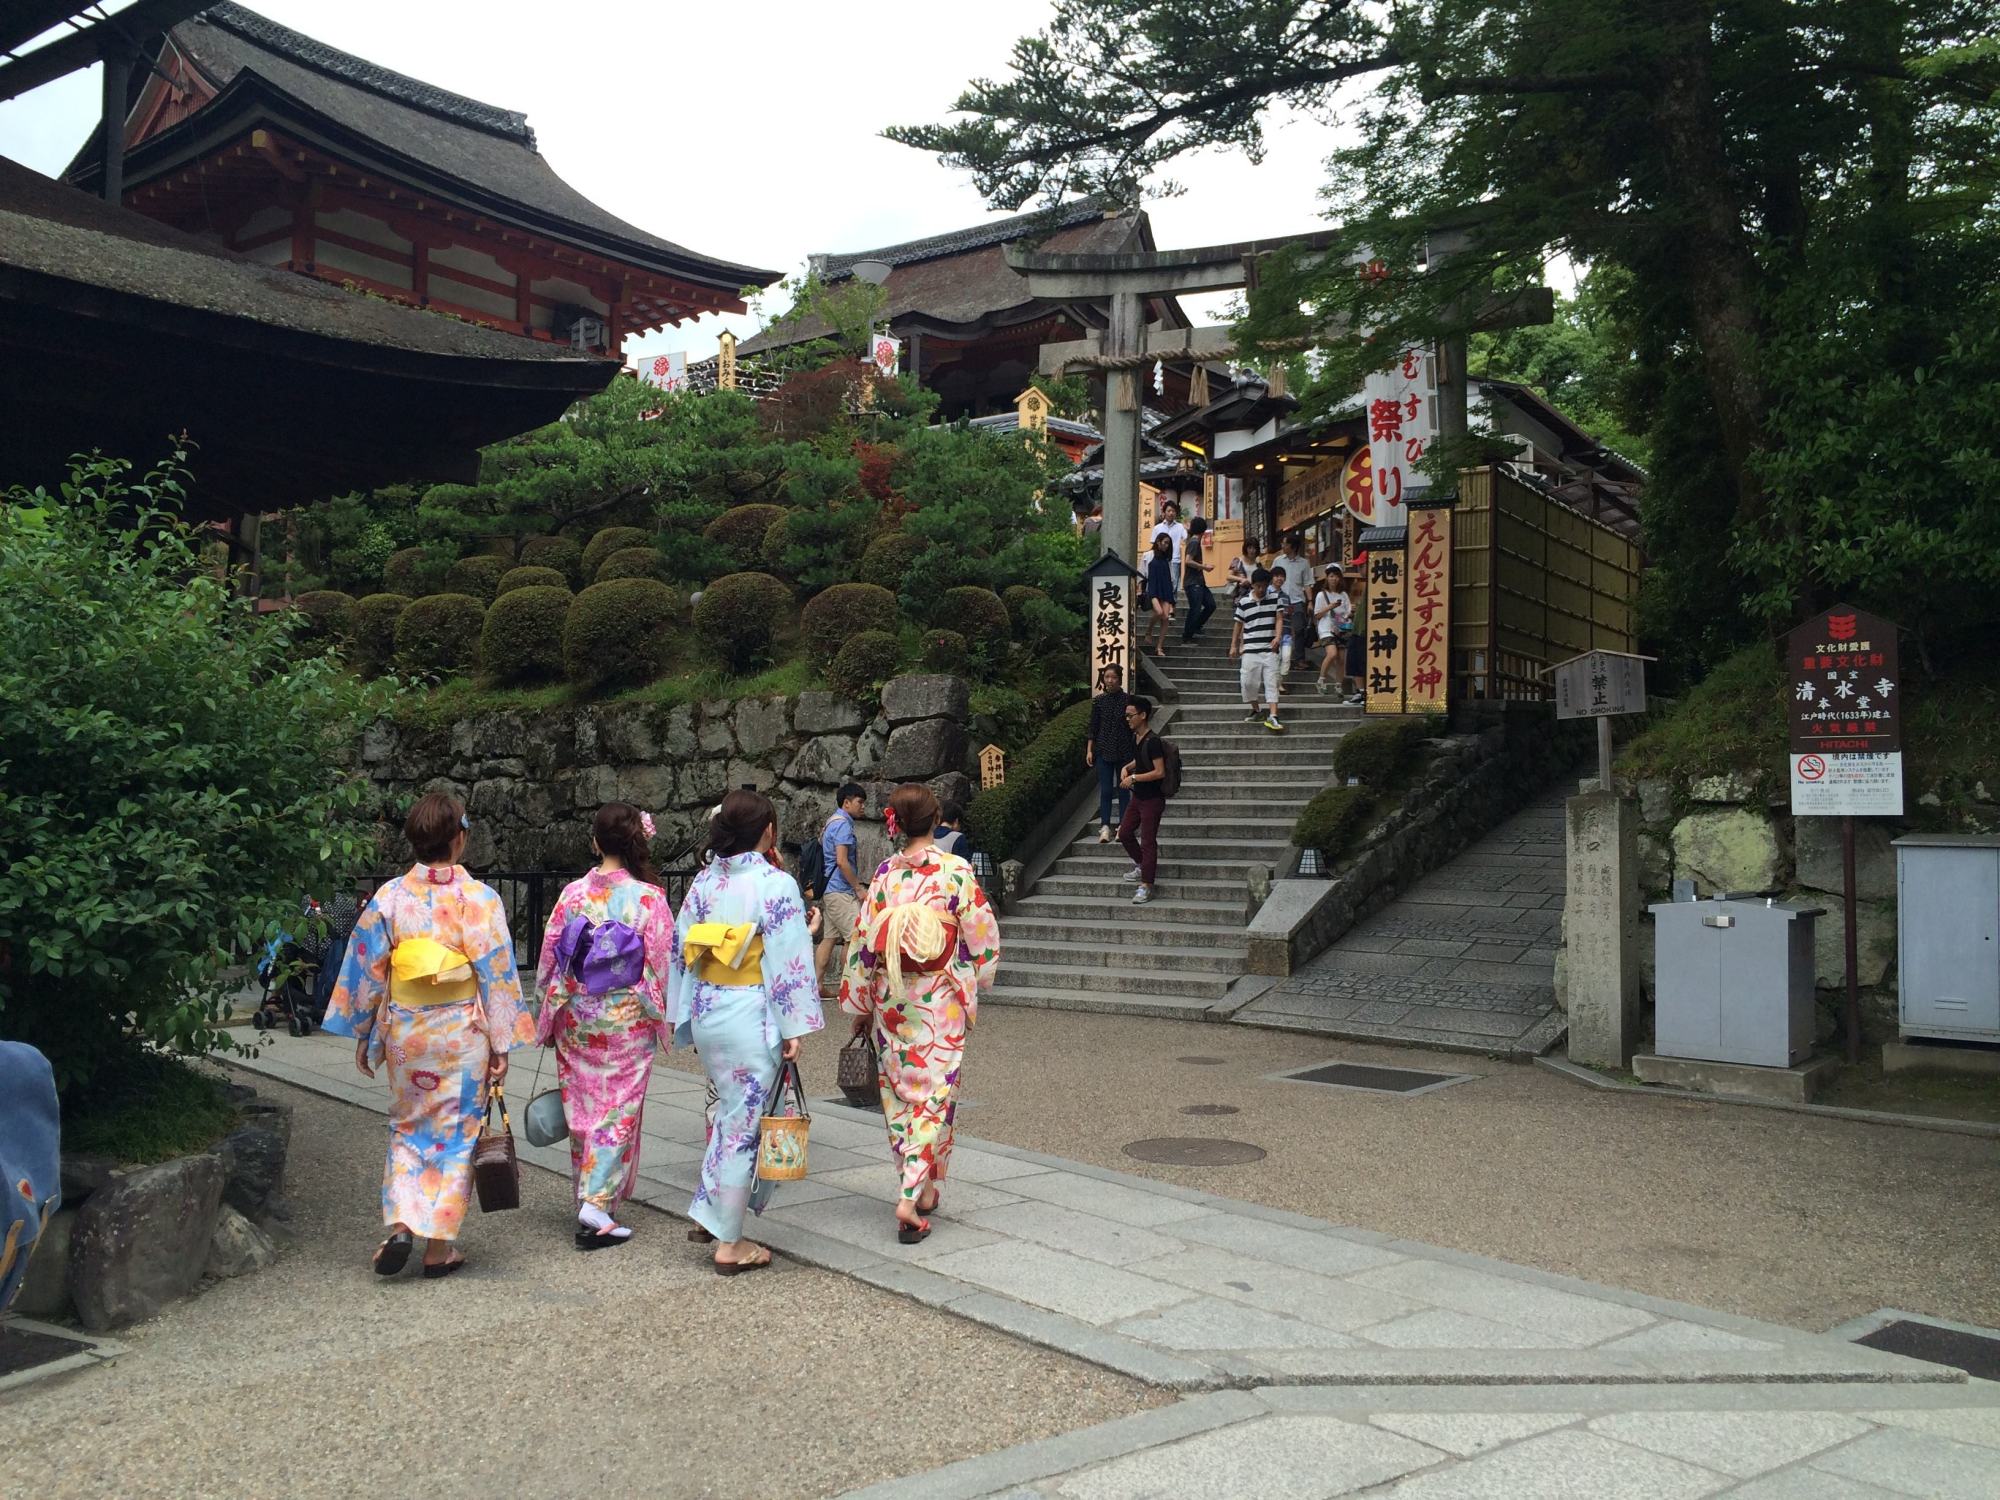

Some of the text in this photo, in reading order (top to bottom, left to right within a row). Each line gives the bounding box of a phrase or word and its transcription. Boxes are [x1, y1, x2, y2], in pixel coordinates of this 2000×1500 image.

[1371, 398, 1402, 507] 祭り
[1410, 512, 1444, 699] えんむすびの神
[1369, 557, 1398, 694] 地主神社
[1815, 641, 1871, 653] 文化財愛護
[1827, 670, 1859, 680] 国宝
[1592, 674, 1608, 705] 禁止
[1795, 677, 1895, 701] 清水寺
[1591, 705, 1625, 715] SMOKING
[1817, 696, 1871, 710] 本堂
[1820, 740, 1868, 749] HITACHI
